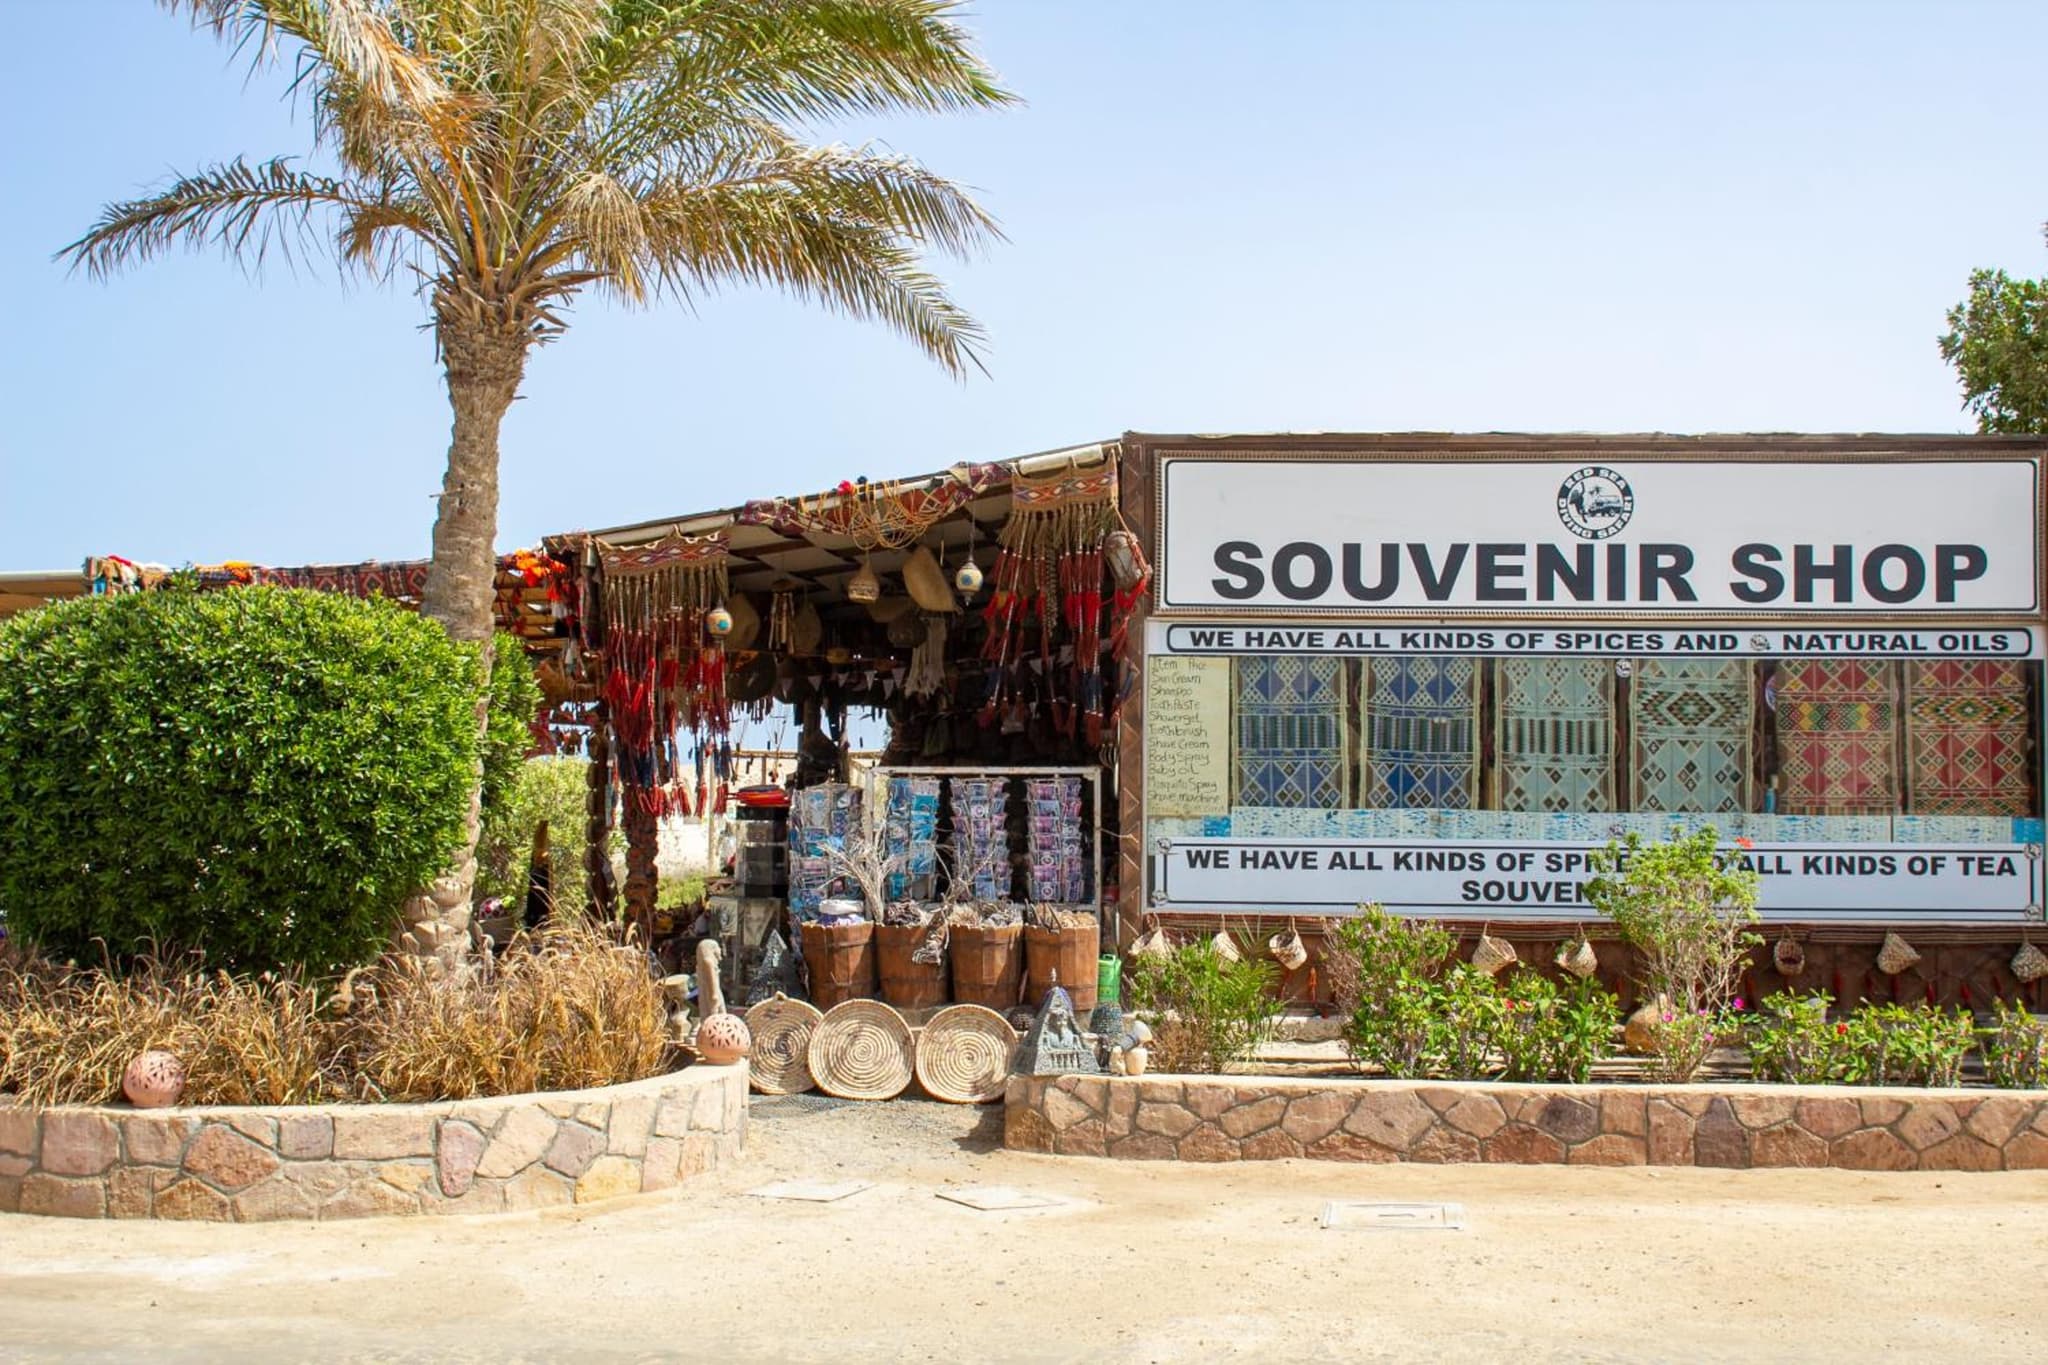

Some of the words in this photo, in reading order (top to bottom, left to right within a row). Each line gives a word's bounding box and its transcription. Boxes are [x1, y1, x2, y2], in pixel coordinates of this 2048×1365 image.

[1212, 541, 1698, 602] SOUVENIR
[1730, 543, 1988, 604] SHOP
[1190, 631, 1234, 647] WE
[1245, 631, 1323, 648] HAVE
[1335, 632, 1390, 648] ALL
[1400, 632, 1494, 649] KINDS
[1506, 632, 1545, 649] OF
[1556, 633, 1664, 650] SPICES
[1674, 634, 1738, 650] AND
[1783, 634, 1927, 651] NATURAL
[1939, 634, 2009, 652] OILS
[1186, 849, 1230, 869] WE
[1240, 850, 1318, 870] HAVE
[1327, 851, 1383, 871] ALL
[1393, 852, 1486, 872] KINDS
[1496, 852, 1535, 872] OF
[1803, 855, 1897, 876] KINDS
[1907, 855, 1947, 876] OF
[1956, 856, 2017, 877] TEA
